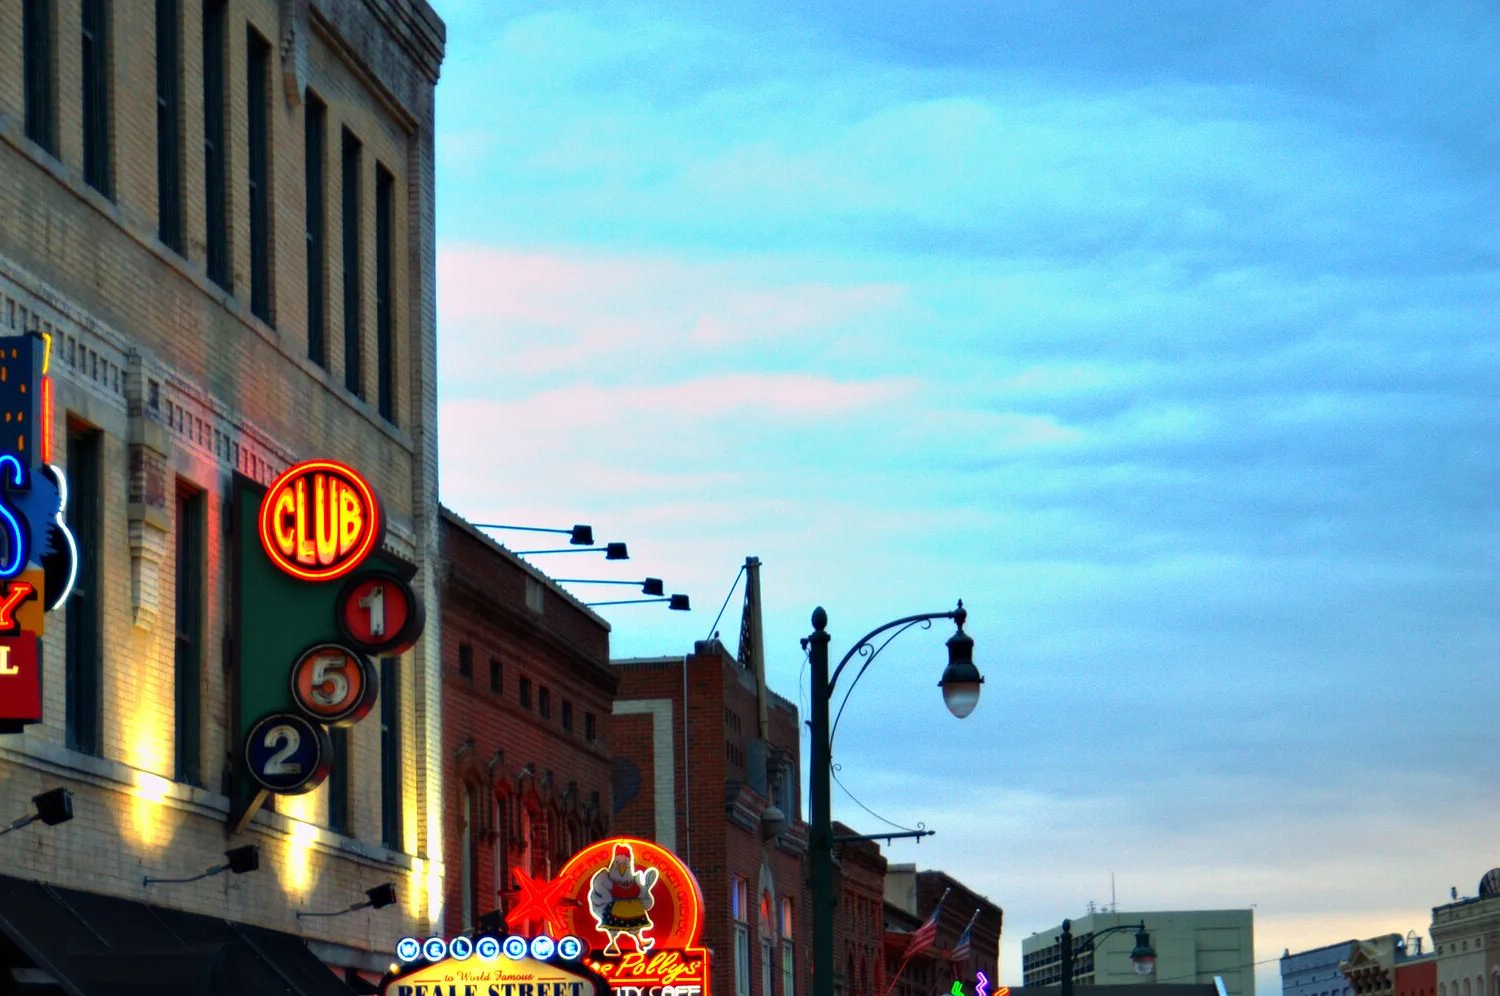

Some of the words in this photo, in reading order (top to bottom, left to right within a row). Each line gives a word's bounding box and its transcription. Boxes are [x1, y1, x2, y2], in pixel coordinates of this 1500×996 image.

[273, 473, 363, 566] CLUB
[358, 585, 386, 638] 1
[309, 655, 349, 707] 5
[263, 723, 302, 776] 2
[397, 937, 582, 961] WELCOME
[445, 974, 454, 982] to
[457, 972, 491, 981] World
[495, 970, 534, 981] Famous
